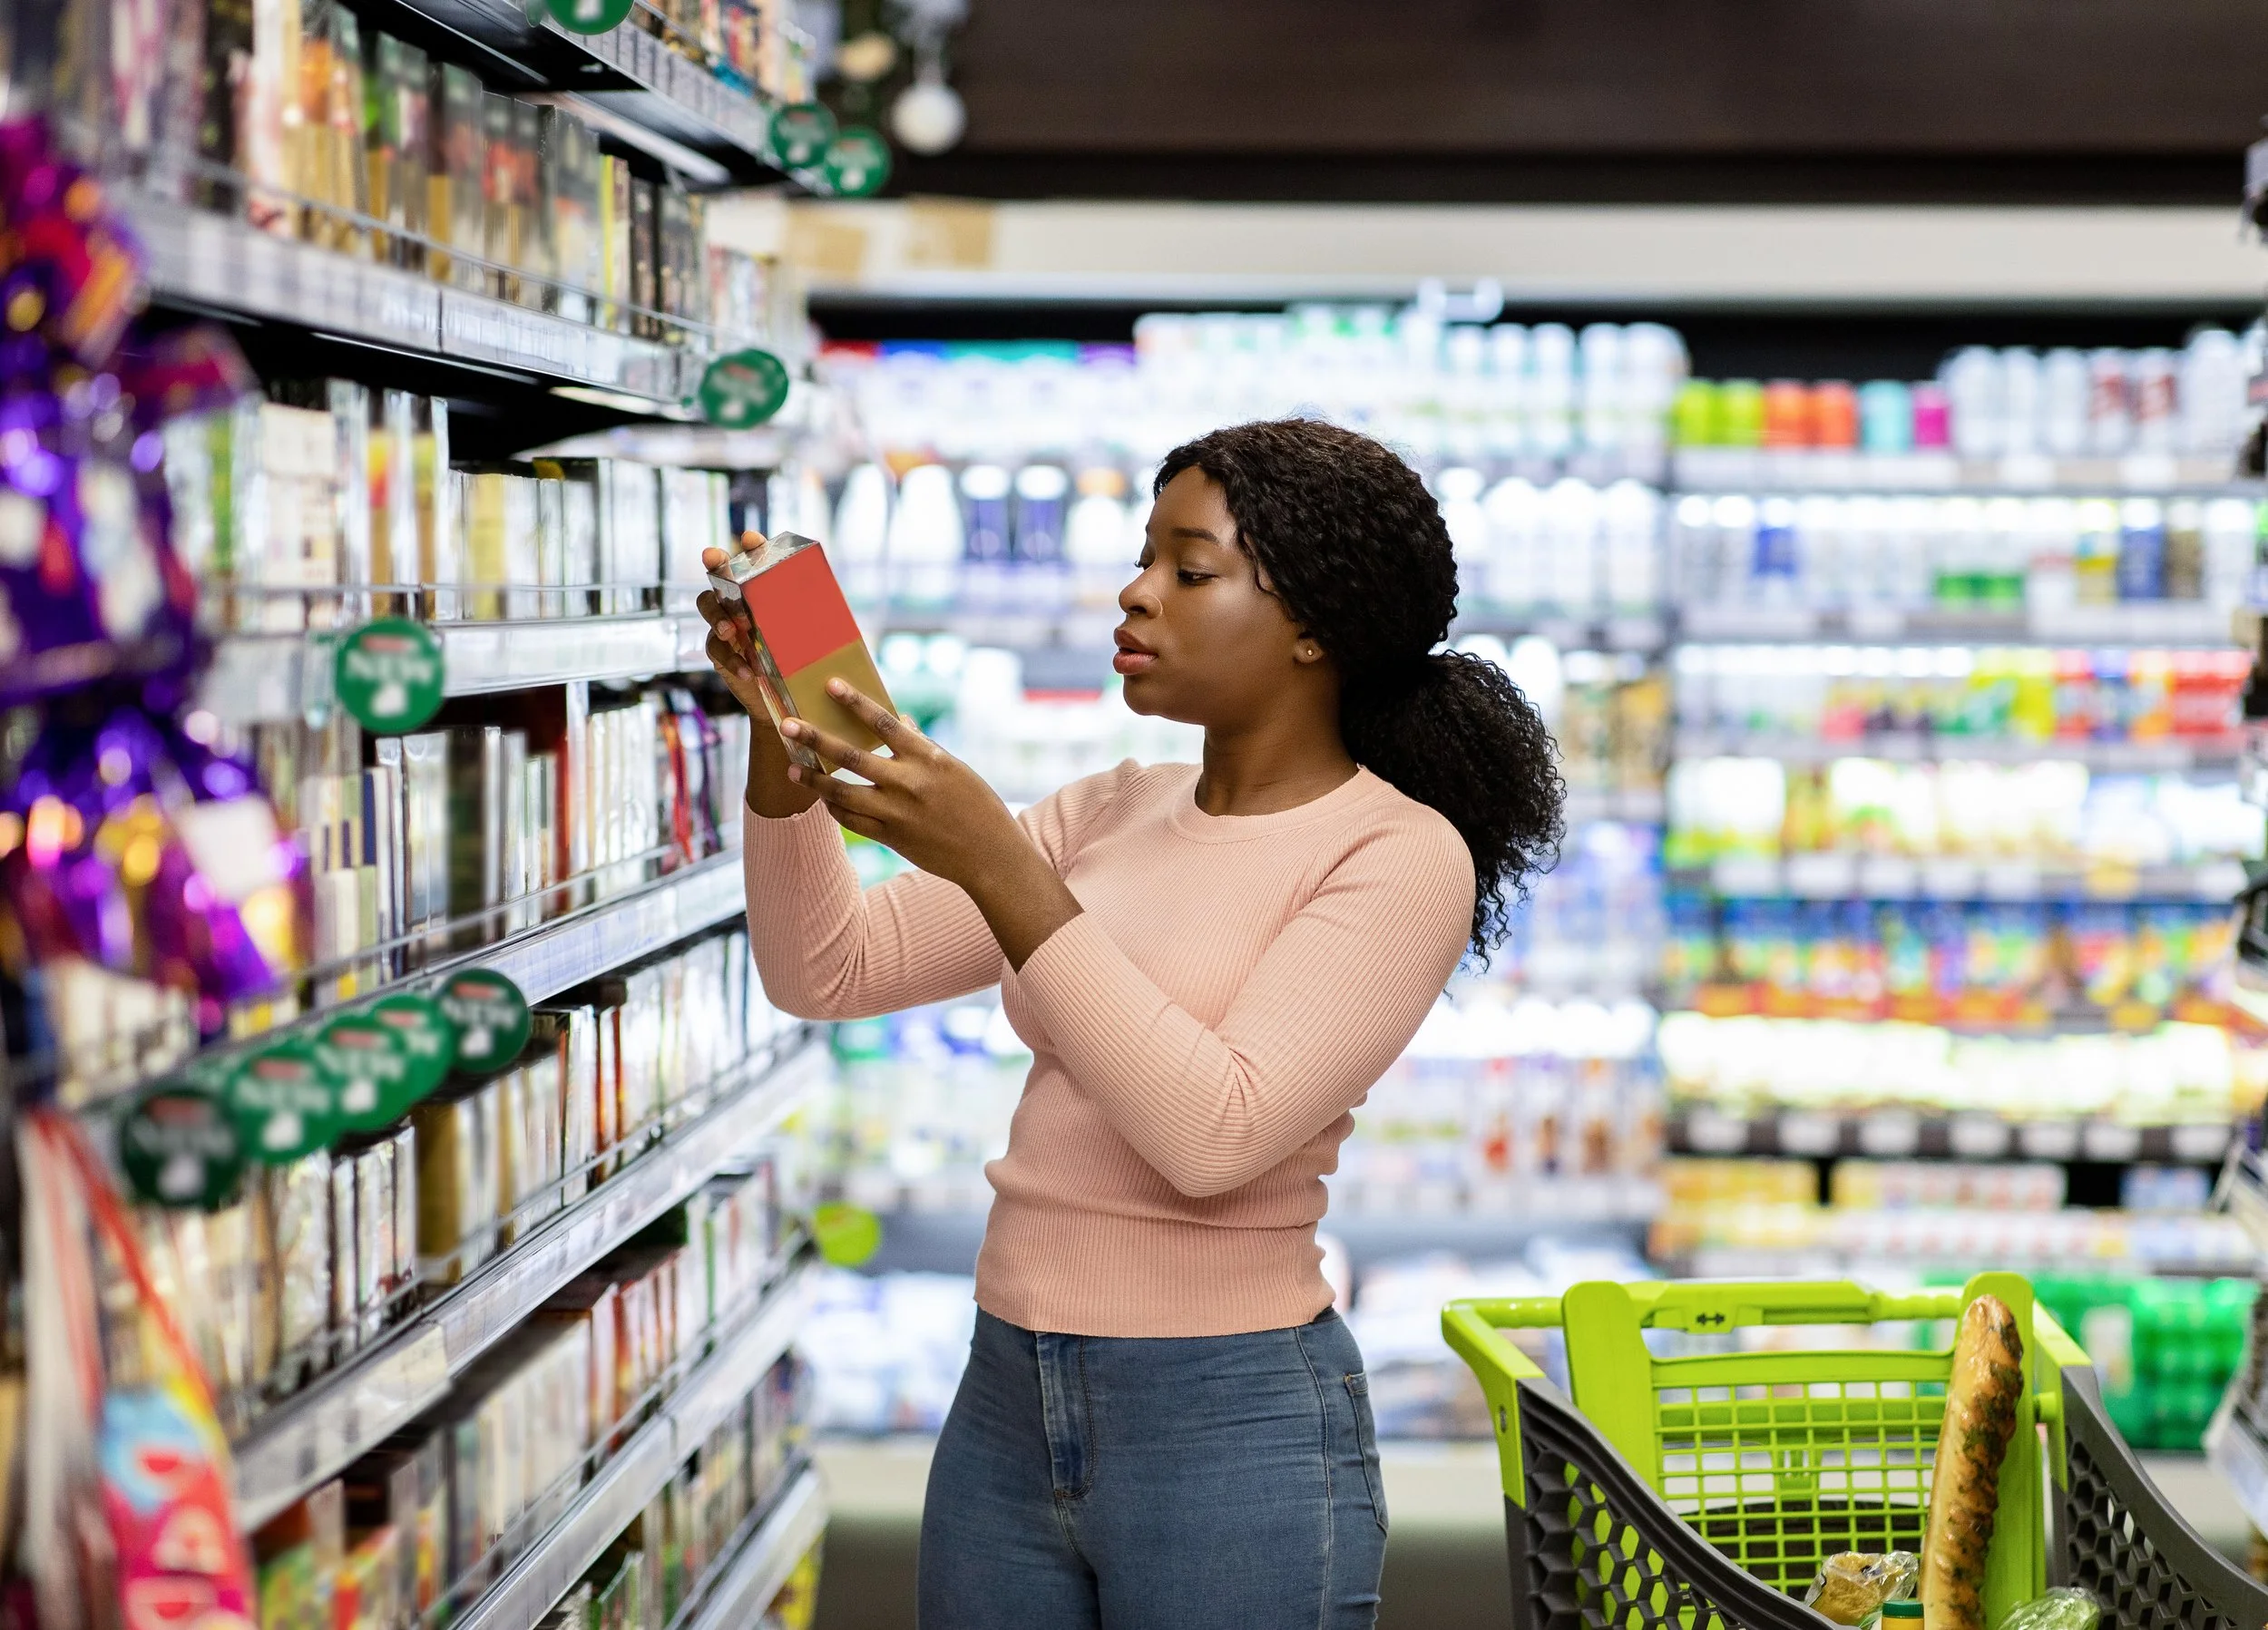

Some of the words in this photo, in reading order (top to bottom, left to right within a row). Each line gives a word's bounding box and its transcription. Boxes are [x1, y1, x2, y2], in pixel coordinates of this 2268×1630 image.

[347, 649, 434, 687] NEW
[440, 998, 519, 1030] NEW
[315, 1045, 403, 1079] NEW
